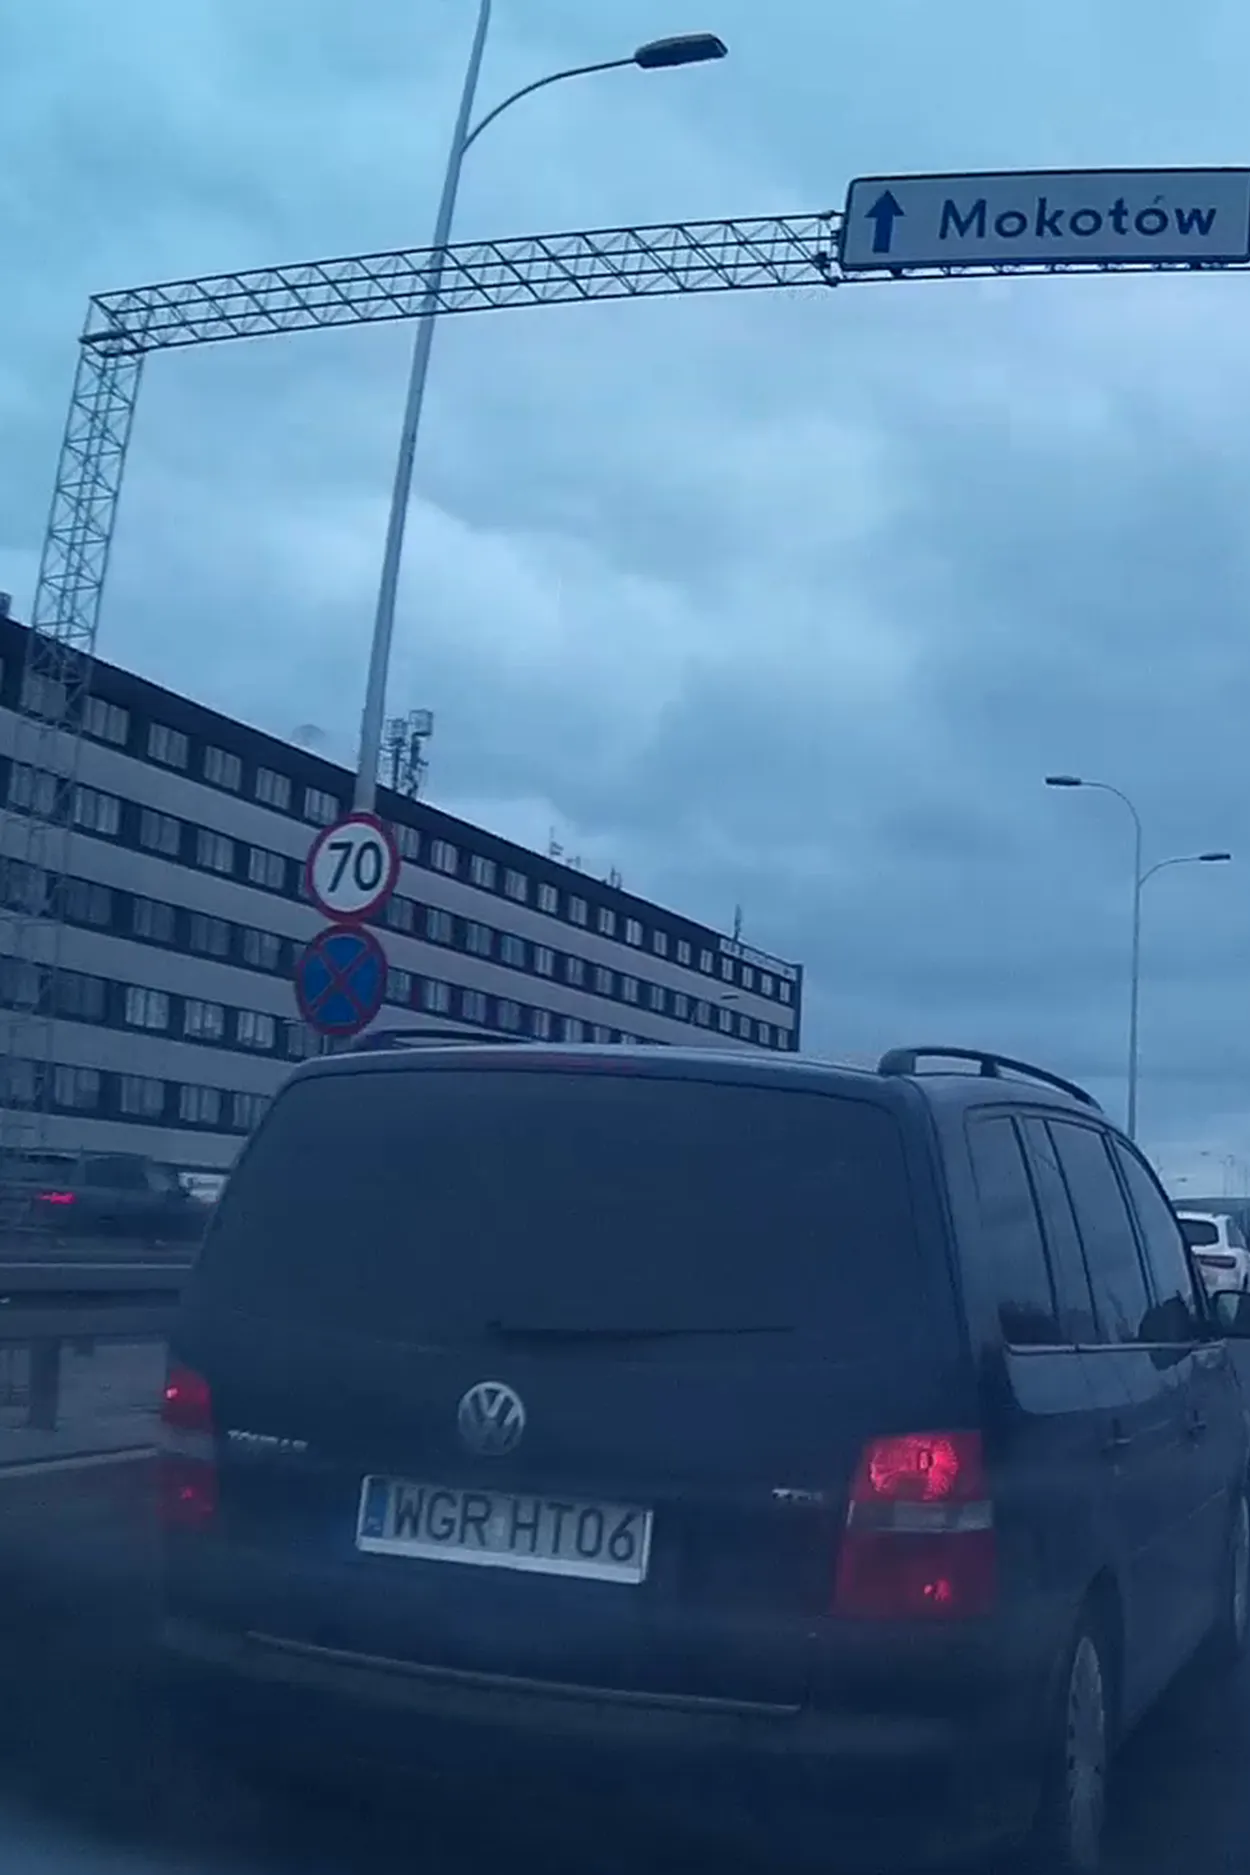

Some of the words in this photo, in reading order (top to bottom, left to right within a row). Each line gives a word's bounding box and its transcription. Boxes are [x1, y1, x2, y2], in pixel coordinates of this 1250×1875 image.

[939, 194, 1218, 240] Mokotów
[328, 841, 382, 892] 70
[394, 1487, 490, 1547] WGR
